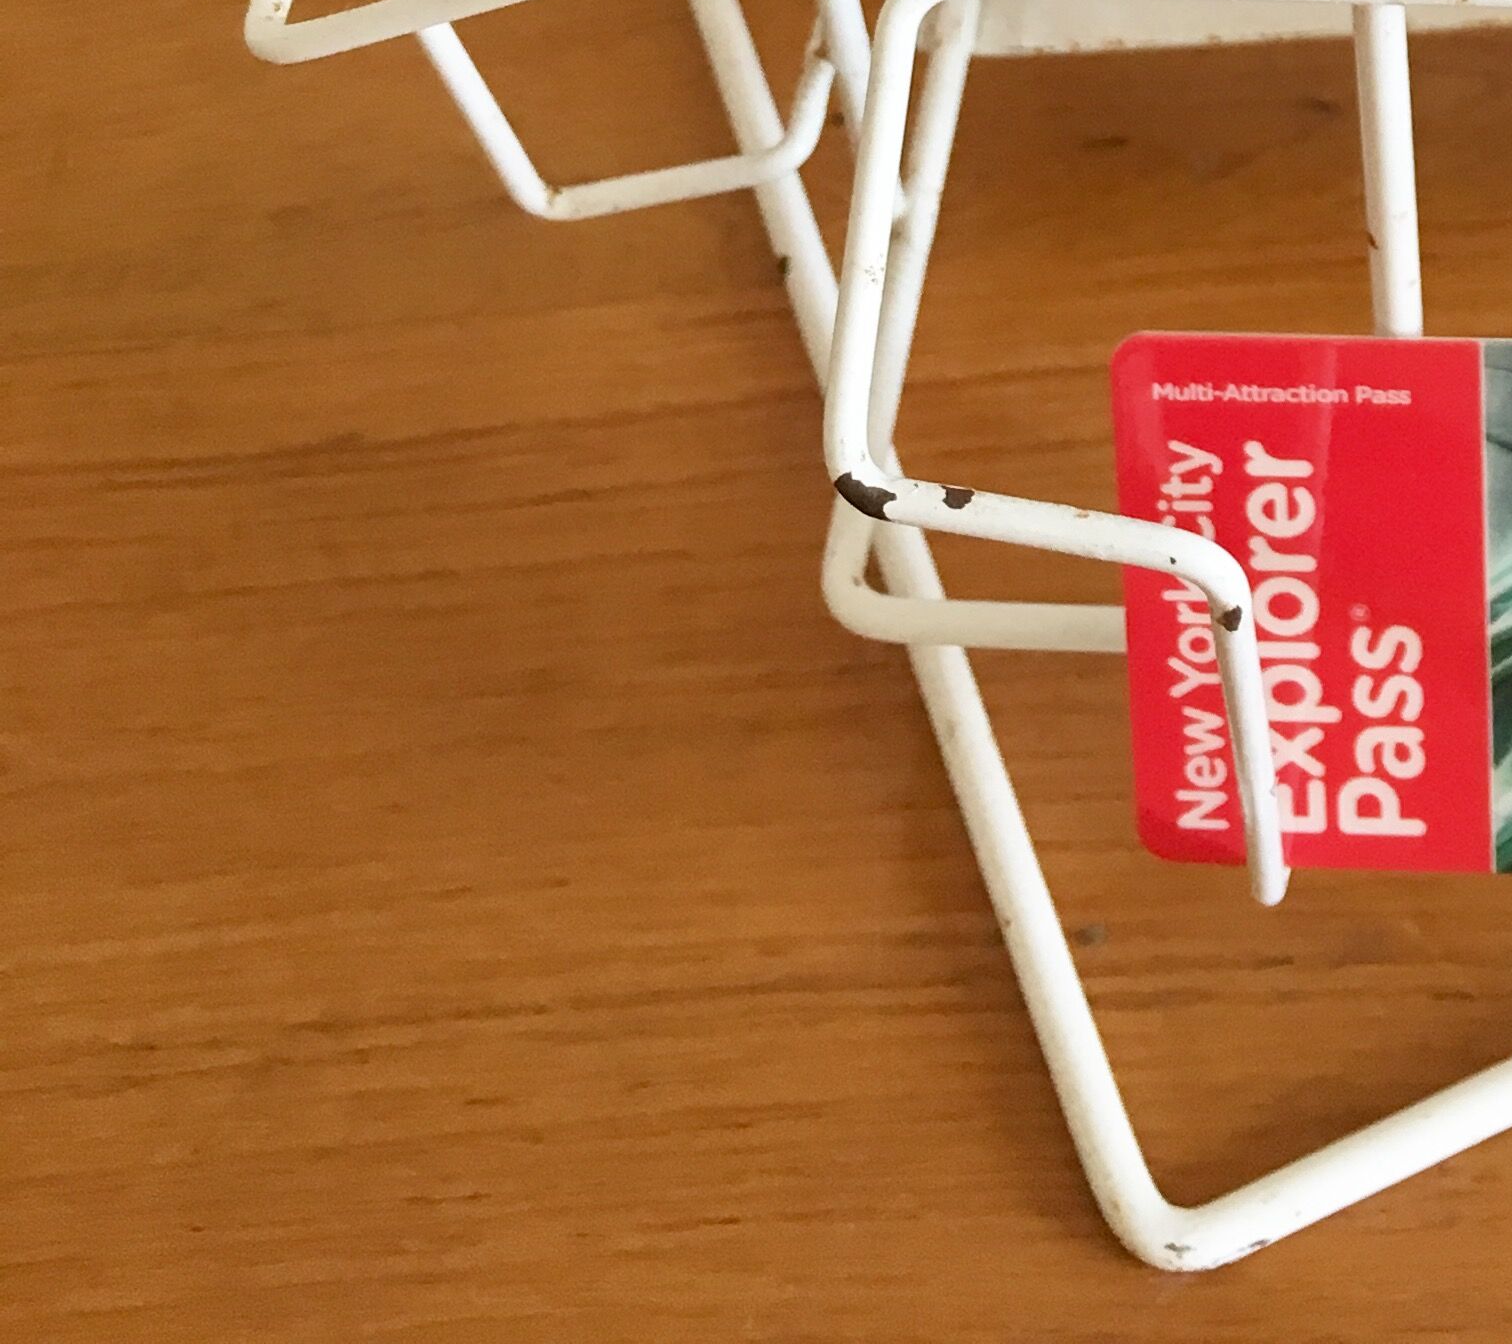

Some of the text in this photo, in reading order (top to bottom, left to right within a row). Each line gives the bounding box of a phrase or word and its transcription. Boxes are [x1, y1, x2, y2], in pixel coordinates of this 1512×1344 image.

[1151, 382, 1413, 406] Multi-Attraction Pass
[1242, 439, 1342, 836] Explorer
[1174, 707, 1231, 831] New
[1336, 624, 1428, 837] Pass
